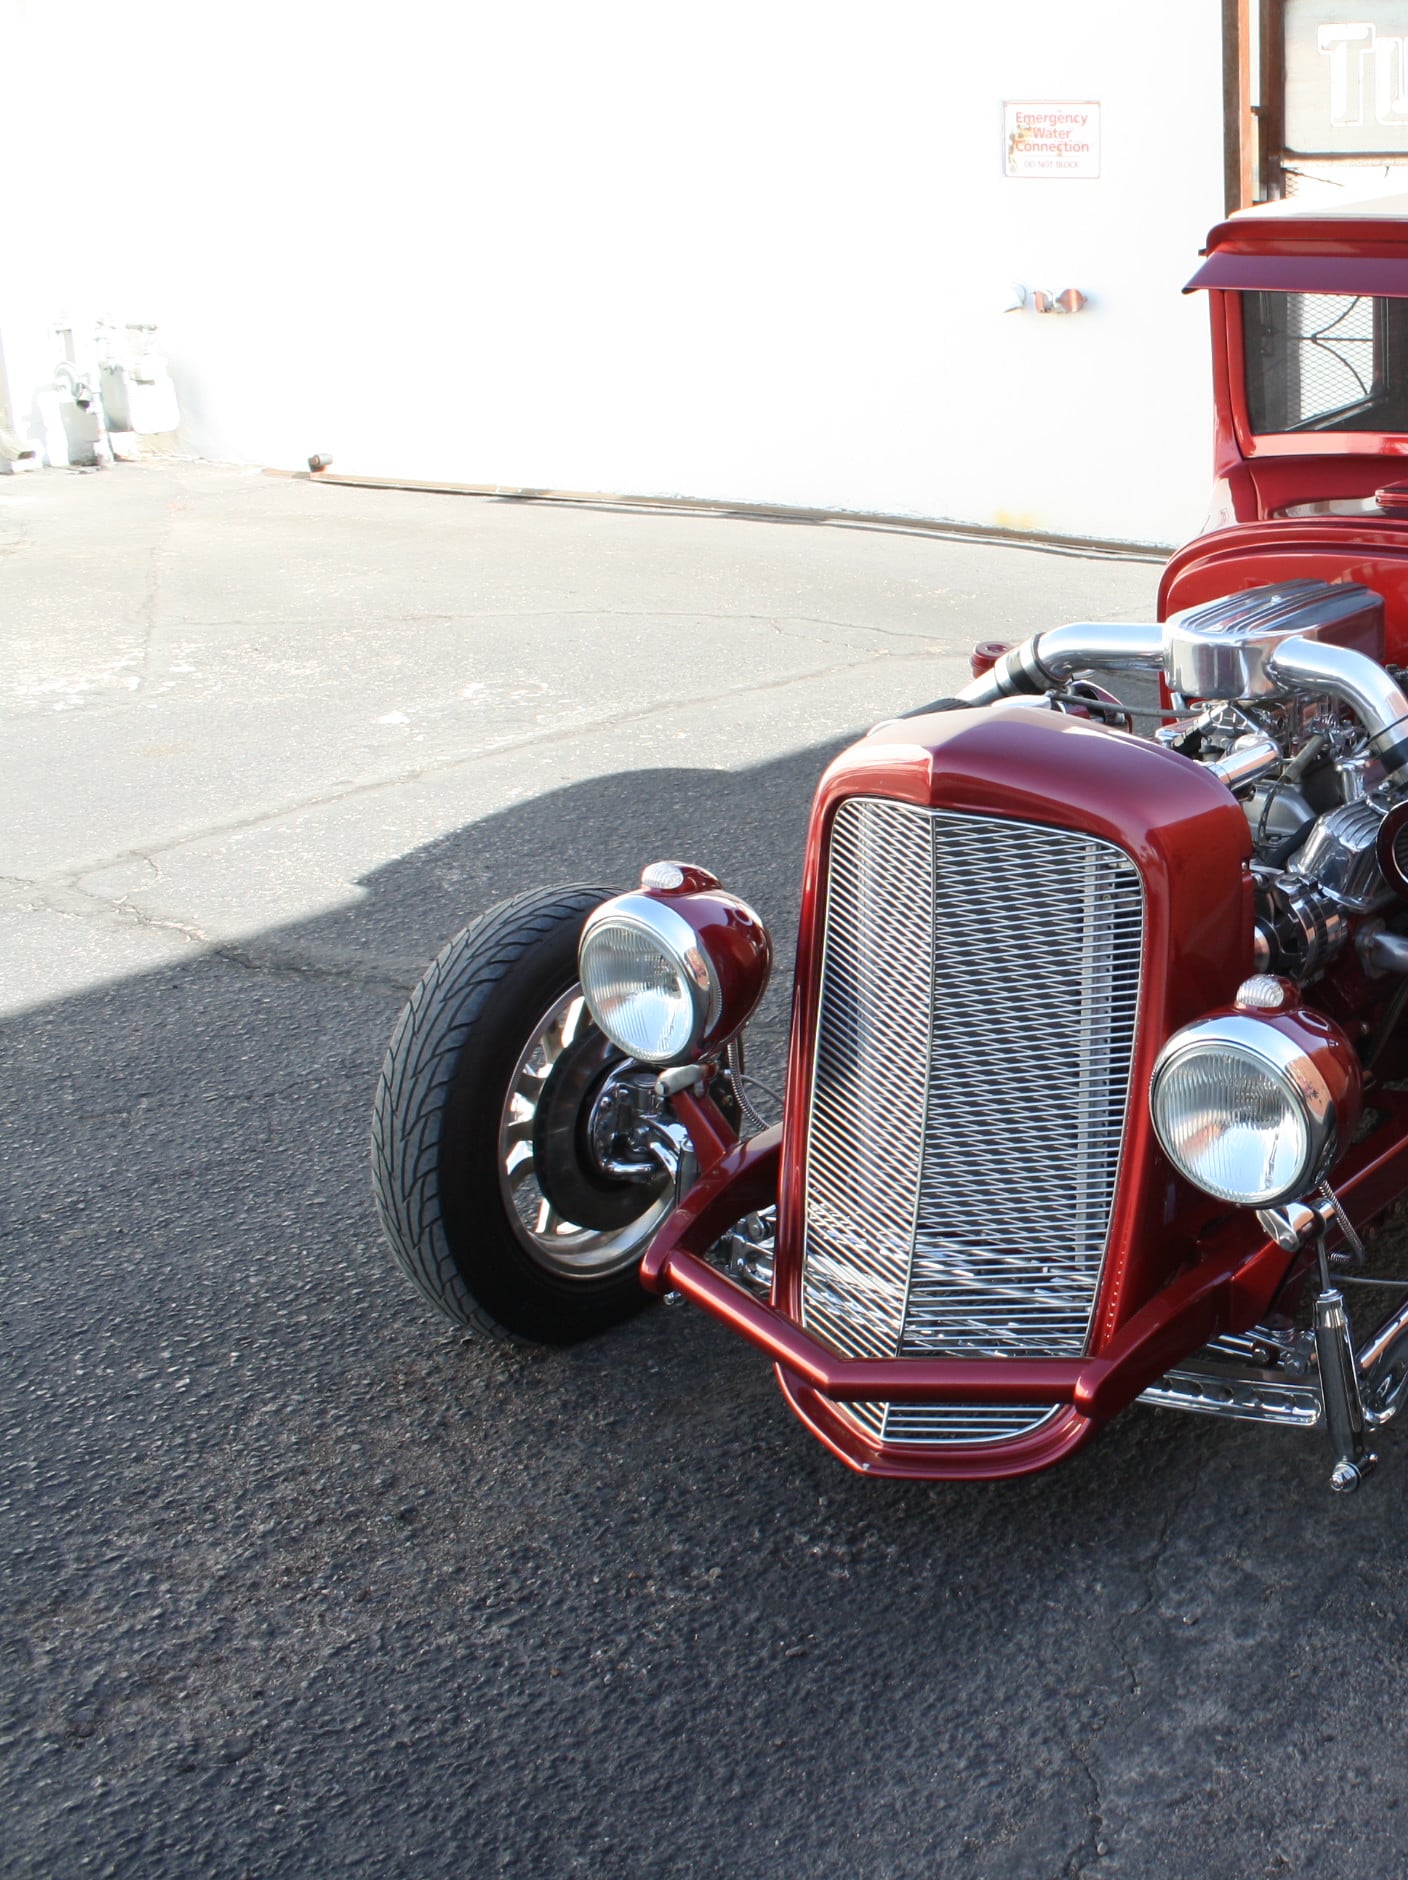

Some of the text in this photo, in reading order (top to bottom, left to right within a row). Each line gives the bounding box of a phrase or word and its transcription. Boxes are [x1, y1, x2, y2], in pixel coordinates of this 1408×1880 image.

[1015, 111, 1089, 127] Emergency
[1033, 127, 1073, 139] Water
[1015, 142, 1090, 153] Connection
[1024, 160, 1080, 169] DO NOT BLOCK
